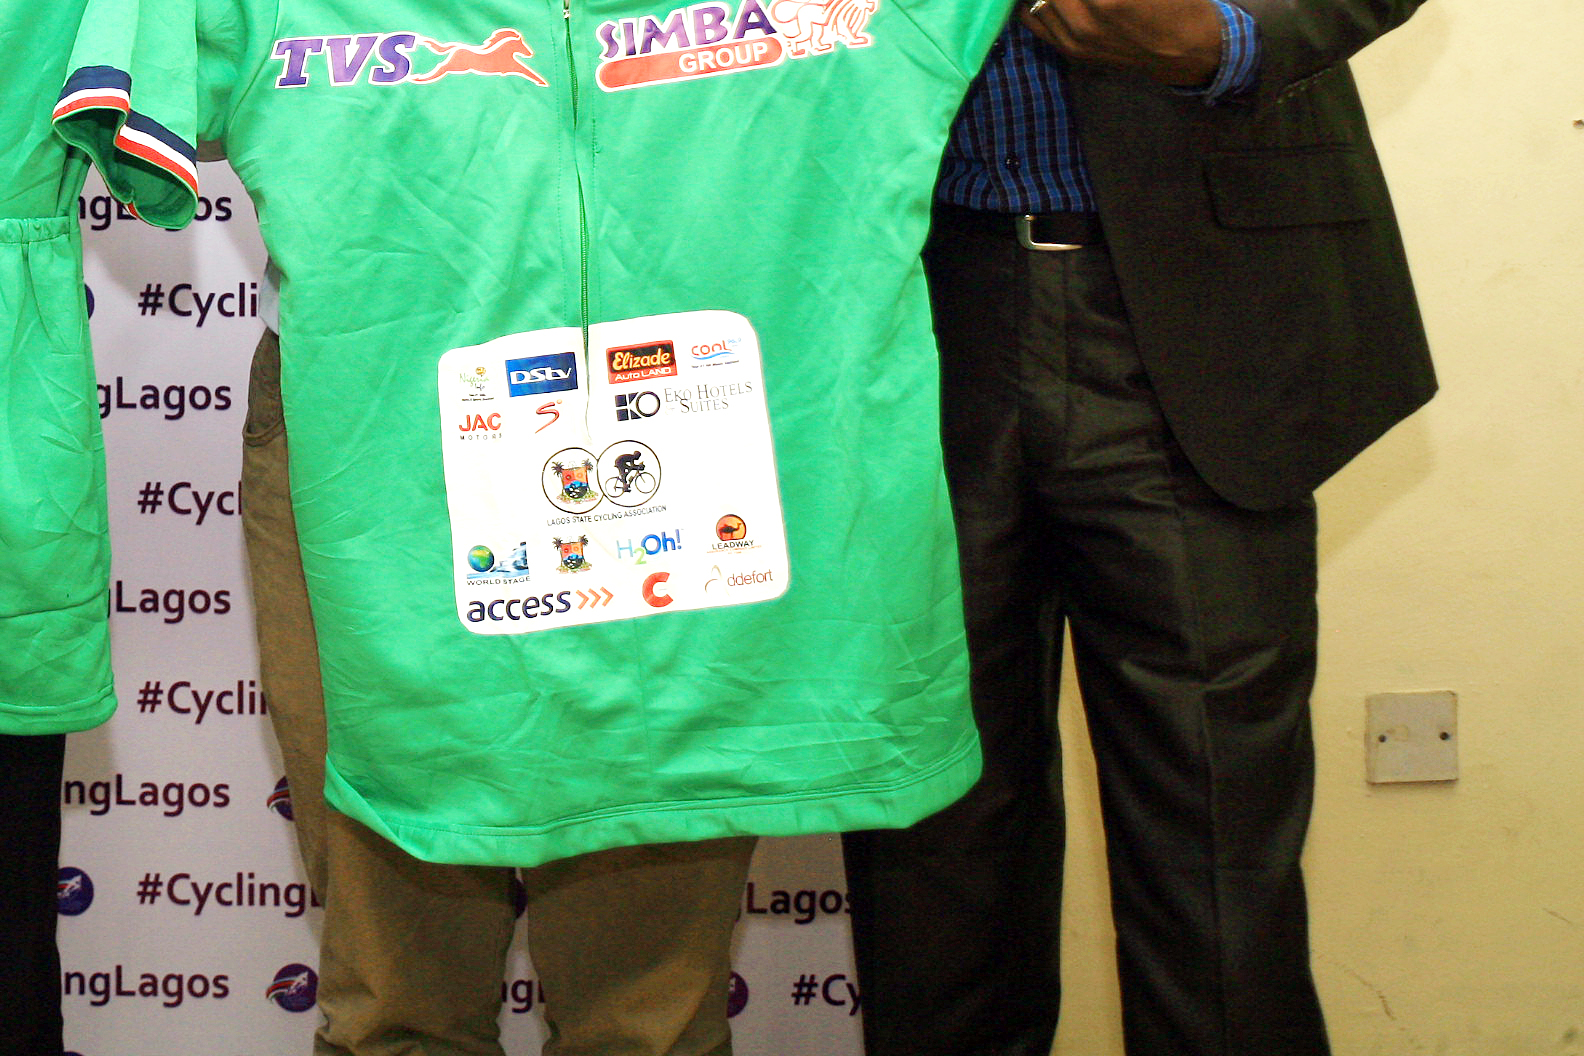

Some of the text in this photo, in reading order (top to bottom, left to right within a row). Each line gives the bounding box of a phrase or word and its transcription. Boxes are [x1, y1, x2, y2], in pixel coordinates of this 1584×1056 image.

[275, 33, 415, 87] TVS
[678, 43, 769, 75] GROUP
[612, 347, 671, 371] Elizade
[614, 366, 672, 382] Auto LAND
[679, 398, 729, 414] SUITES
[458, 412, 502, 432] JAC
[547, 504, 667, 526] LAGOS STATE CYCLING ASSOCIATION
[711, 539, 754, 550] LEADWAY
[467, 575, 531, 586] WORLD STAGE
[466, 590, 572, 623] access
[63, 773, 230, 817] ngLagos
[63, 964, 230, 1008] ngLagos
